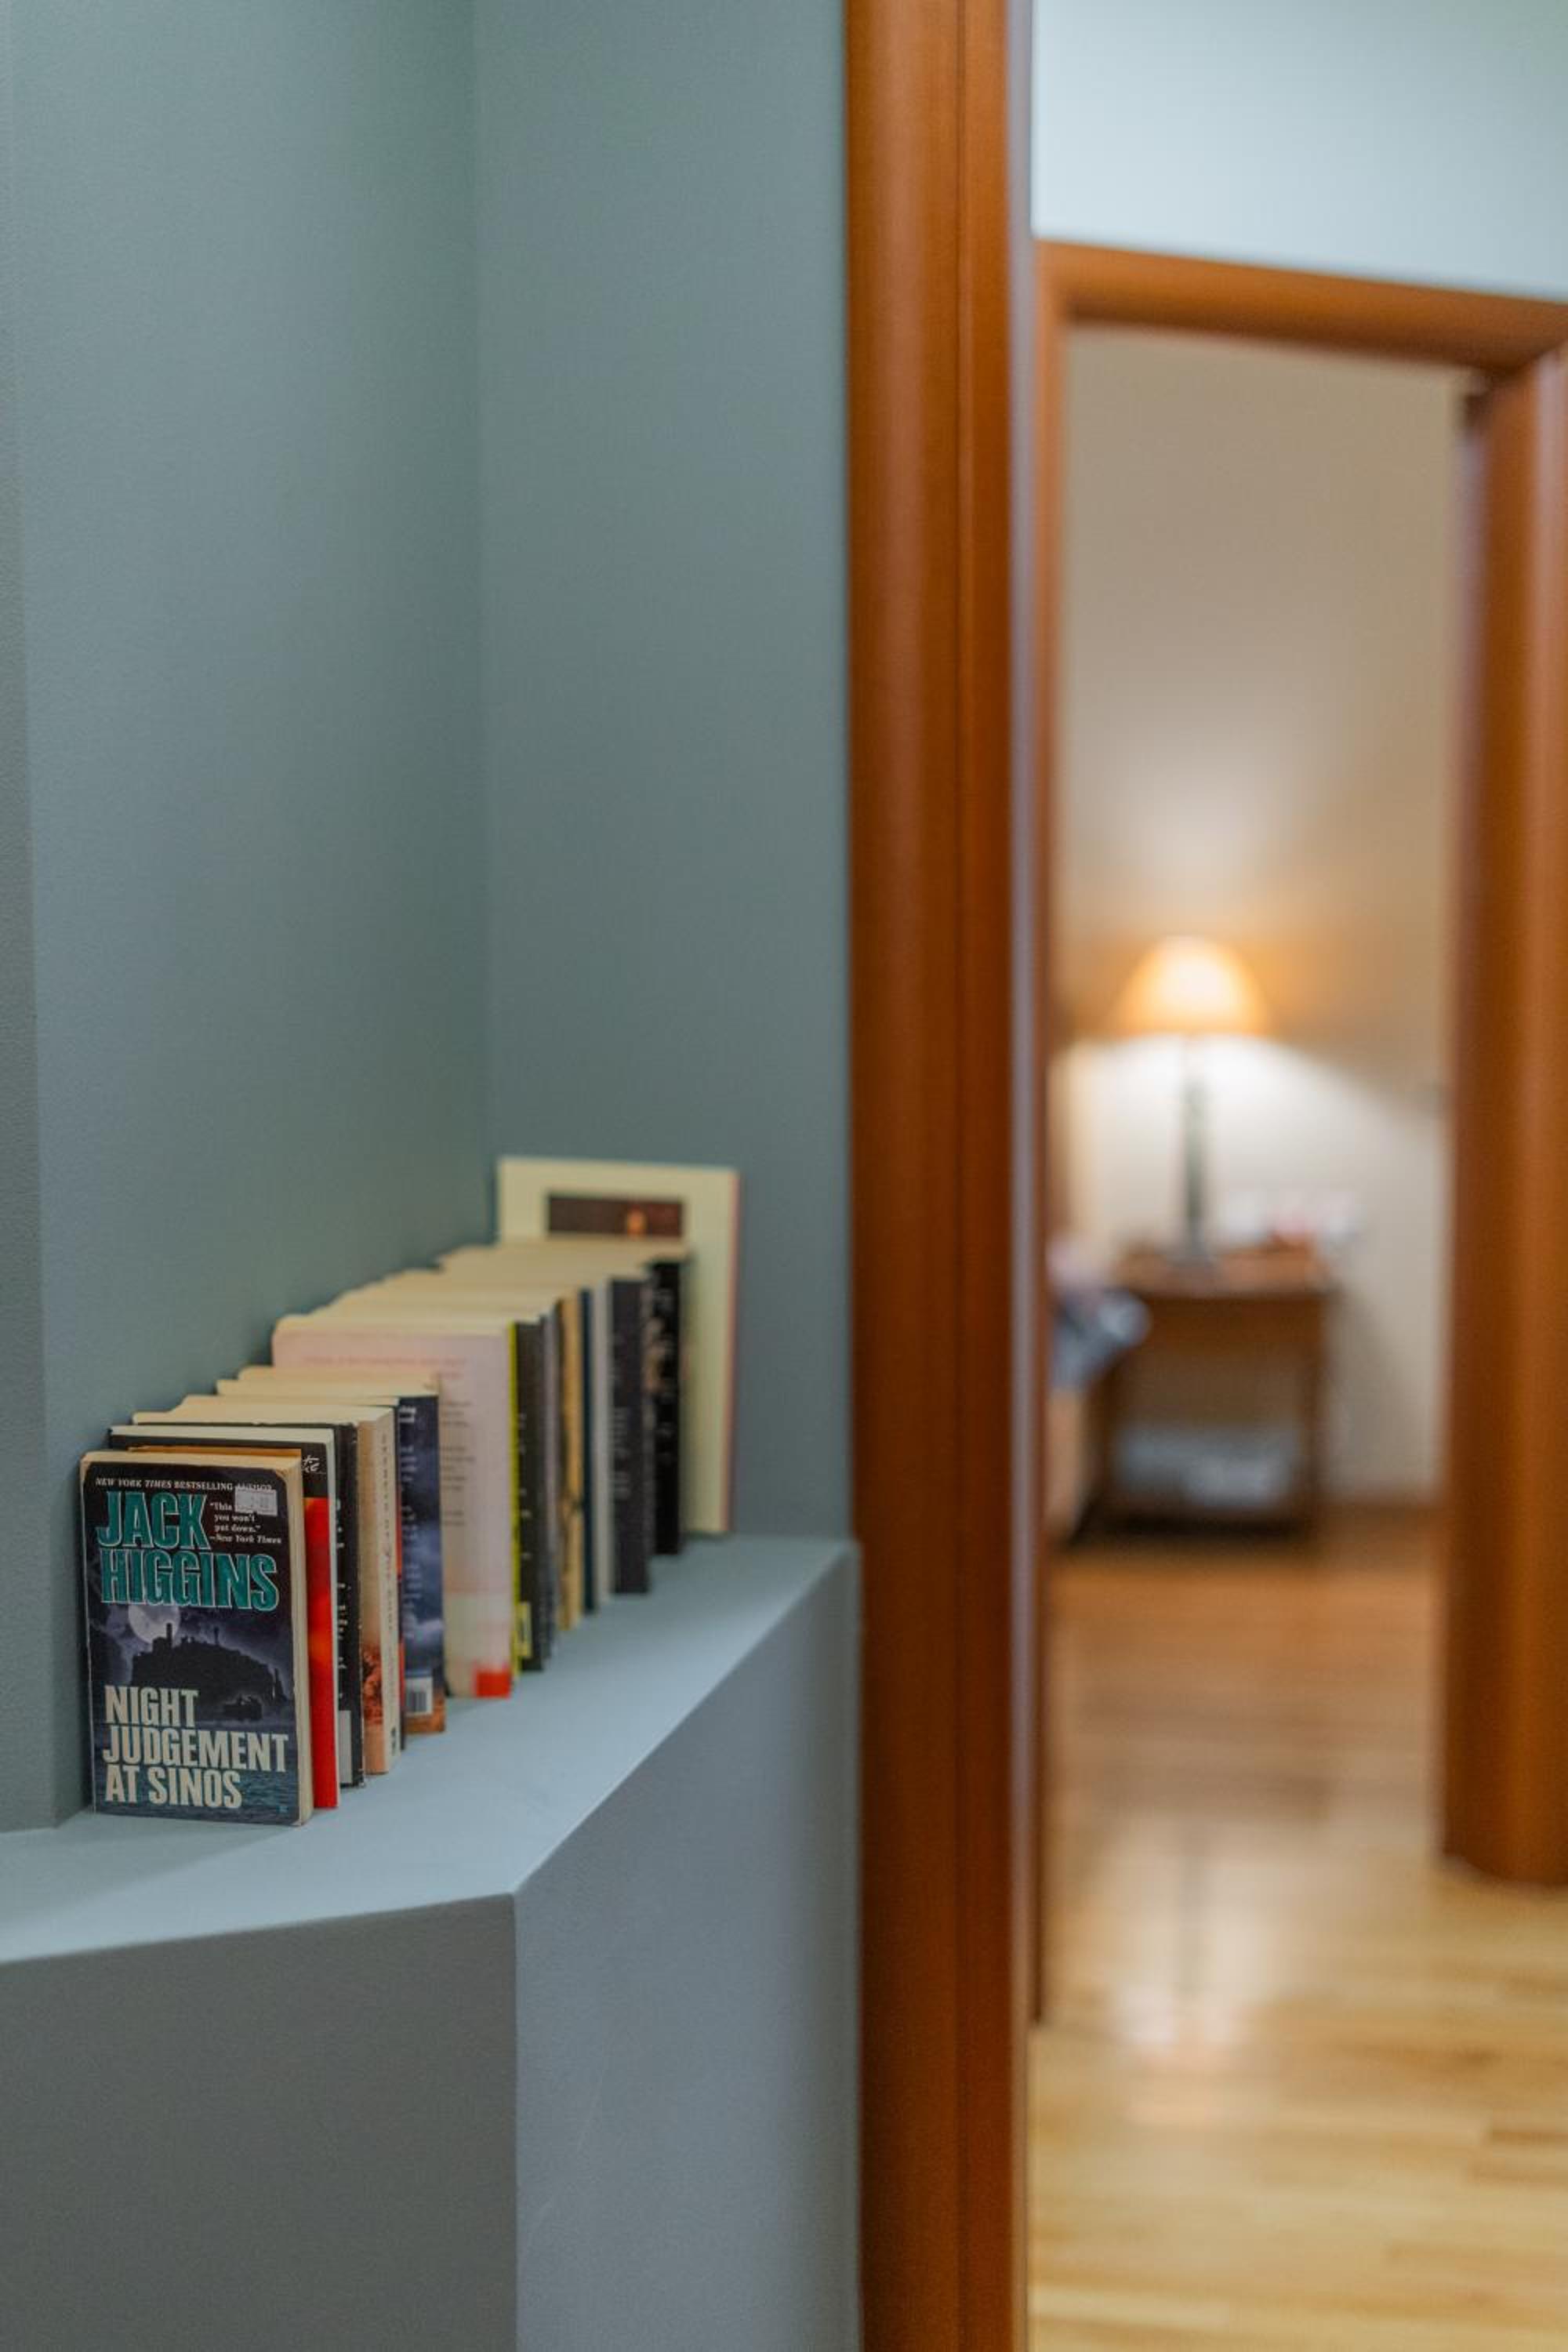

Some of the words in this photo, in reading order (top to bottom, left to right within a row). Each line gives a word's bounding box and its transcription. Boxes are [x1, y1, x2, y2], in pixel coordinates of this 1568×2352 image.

[96, 1478, 114, 1486] NEW
[118, 1479, 141, 1487] YORK
[143, 1479, 172, 1488] TIMES
[174, 1481, 233, 1490] BESTSELLING
[95, 1490, 212, 1550] JACK
[256, 1535, 281, 1544] Times
[100, 1548, 280, 1612] HIGGINS
[104, 1685, 199, 1727] NIGHT
[102, 1725, 289, 1773] JUDGEMENT
[105, 1765, 140, 1803] AT
[147, 1766, 242, 1809] SINOS
